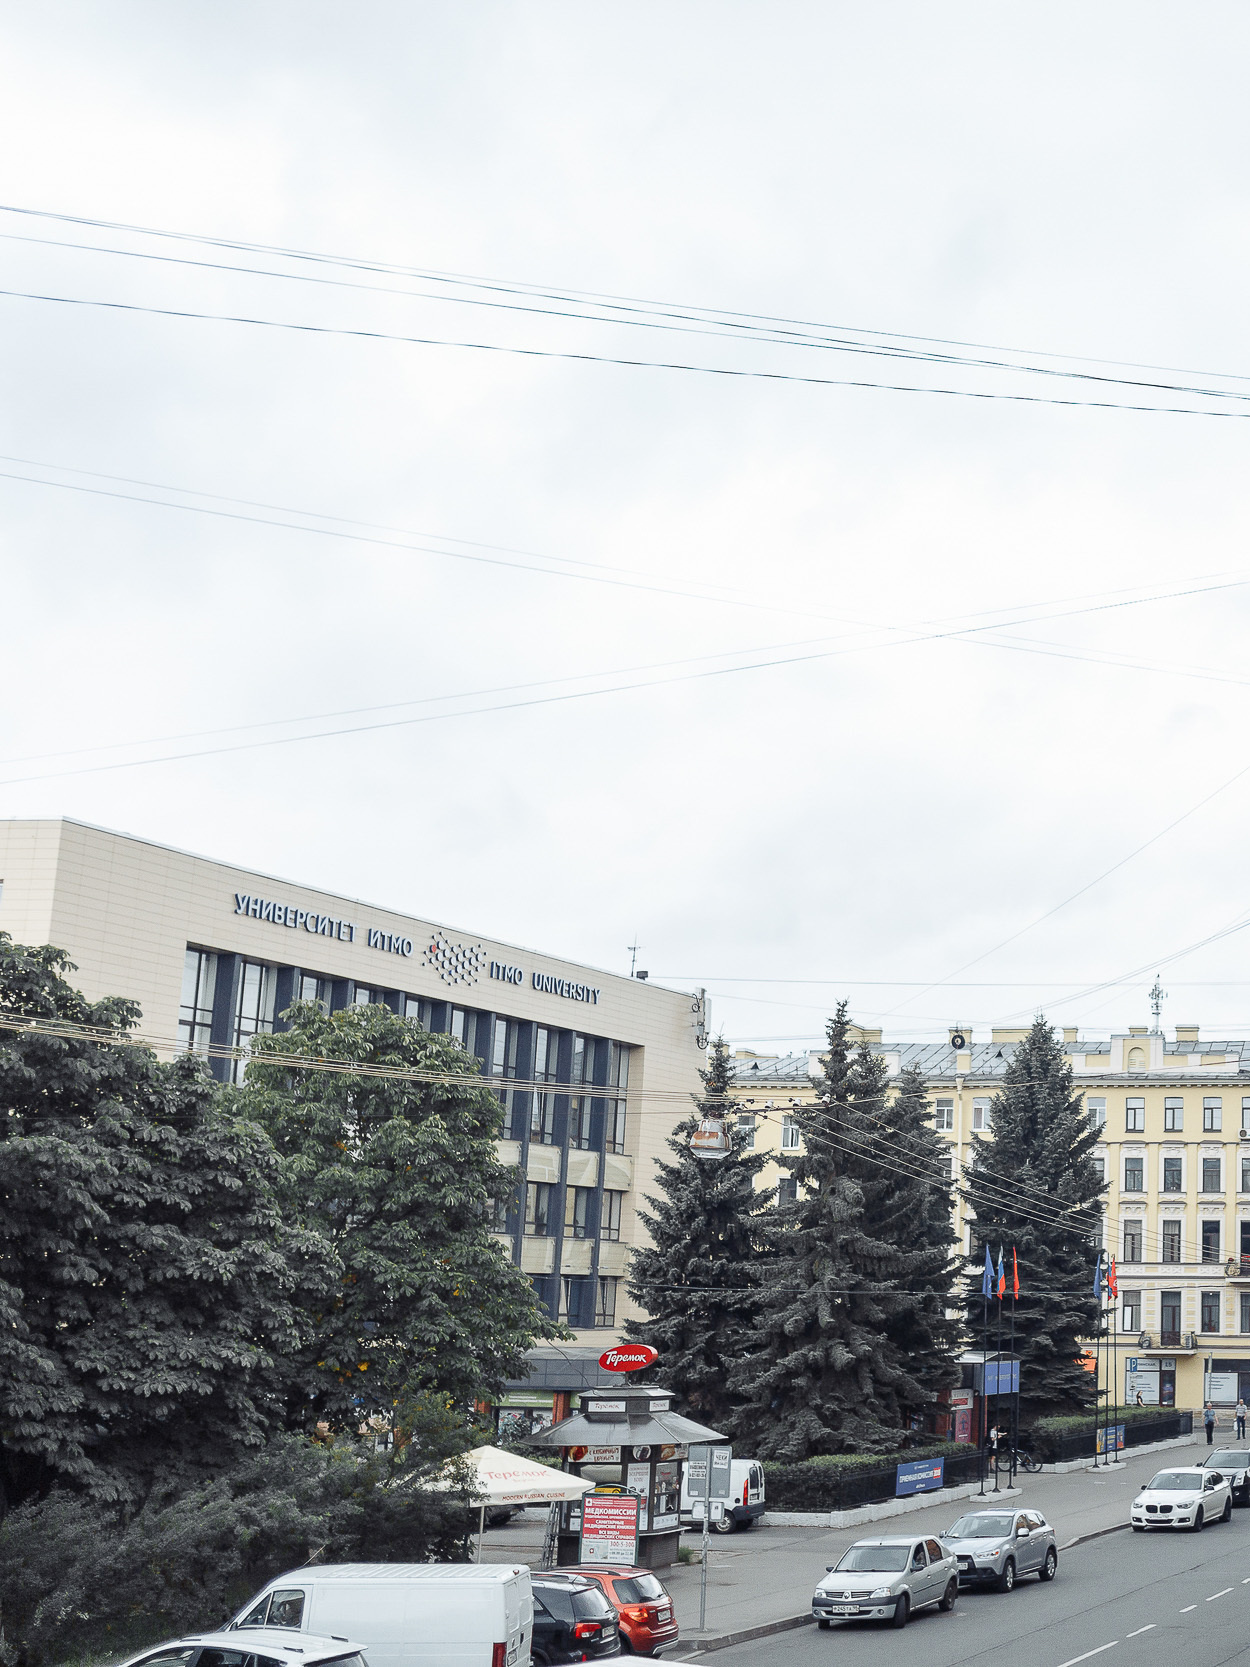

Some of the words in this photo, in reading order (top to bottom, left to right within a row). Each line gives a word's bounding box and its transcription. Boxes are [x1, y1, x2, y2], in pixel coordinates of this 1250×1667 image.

[234, 893, 358, 942] УНИВЕРСИТЕТ
[367, 928, 414, 958] ИТМО
[490, 961, 524, 986] ITMO
[532, 972, 602, 1005] UNIVERSITY
[605, 1350, 647, 1367] Теремок
[483, 1470, 551, 1482] Теремок
